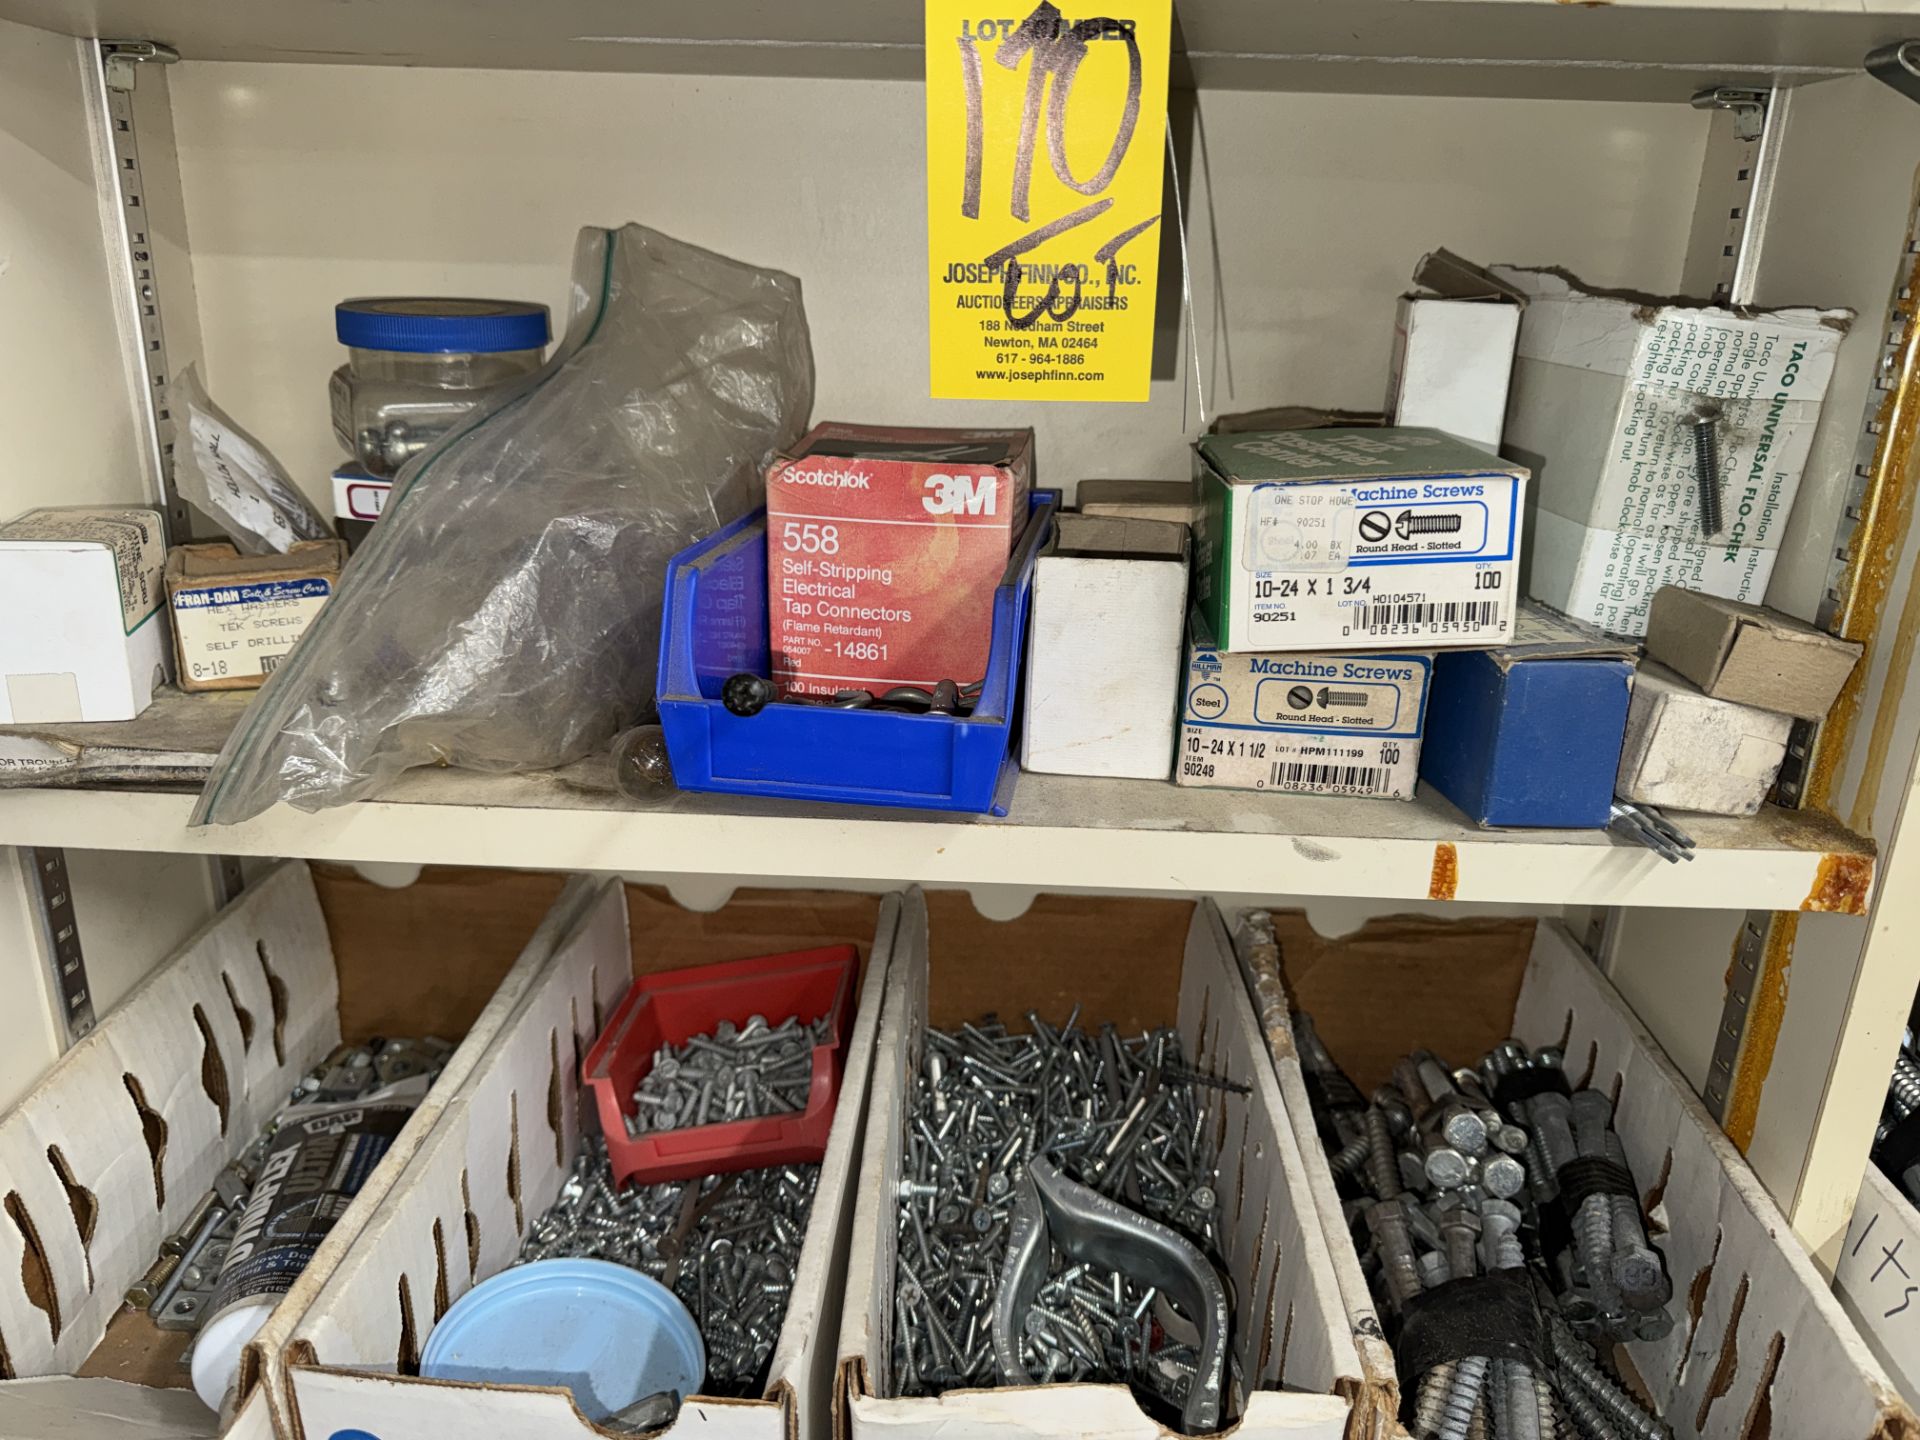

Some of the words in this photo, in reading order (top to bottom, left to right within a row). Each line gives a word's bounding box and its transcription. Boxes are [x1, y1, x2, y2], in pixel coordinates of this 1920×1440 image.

[962, 20, 1014, 41] LOT
[1017, 18, 1137, 42] UMBER
[944, 263, 1011, 285] JOSEPH
[1021, 264, 1059, 285] FINN
[1106, 265, 1142, 286] INC.
[956, 295, 1045, 310] AUCTIOEERS
[979, 320, 1000, 331] 188
[1005, 321, 1063, 332] Ndham
[1067, 321, 1105, 332] Street
[984, 336, 1034, 349] Newton,
[1038, 337, 1058, 348] MA
[1062, 338, 1098, 348] 02464
[1639, 319, 1670, 378] re-tighten
[1655, 321, 1685, 373] packing
[1672, 323, 1702, 375] packing
[1696, 326, 1718, 358] knob
[1738, 332, 1764, 369] angle
[1757, 335, 1779, 366] Taco
[996, 353, 1018, 364] 617
[1029, 354, 1084, 364] 964-1886
[1696, 328, 1732, 394] (operating
[1722, 330, 1747, 375] normal
[1779, 341, 1807, 386] TACO
[976, 370, 1104, 382] www.josephfinn.com
[1622, 384, 1650, 435] packing
[1733, 371, 1766, 429] Universal
[1643, 402, 1662, 427] and
[1636, 432, 1653, 456] turn
[1746, 392, 1789, 481] UNIVERSAL
[1619, 440, 1635, 463] nut.
[1649, 431, 1668, 465] return
[783, 467, 870, 489] Scotchlok
[1626, 460, 1647, 492] knob
[1644, 470, 1658, 481] to
[1675, 465, 1690, 479] To
[922, 474, 997, 515] 3M
[1275, 495, 1292, 505] ONE
[1299, 495, 1323, 505] STOP
[1346, 484, 1418, 502] achine
[1423, 484, 1484, 499] Screws
[1655, 485, 1667, 498] as
[1663, 483, 1682, 518] open,
[1682, 485, 1696, 506] are
[1630, 486, 1654, 531] normal
[1649, 502, 1665, 520] far
[1755, 472, 1788, 541] Installation
[1260, 517, 1278, 526] HF#
[1296, 518, 1326, 527] 90251
[1608, 496, 1637, 559] clock-wise
[1644, 524, 1656, 538] as
[1723, 487, 1757, 563] FLO-CHEK
[783, 522, 839, 554] 558
[1294, 541, 1318, 549] 4.00
[1330, 541, 1342, 550] BX
[1663, 510, 1693, 561] shipped
[1328, 552, 1340, 560] EA
[1356, 543, 1389, 553] Round
[1391, 542, 1418, 552] Head
[1427, 541, 1462, 550] Slotted
[1641, 542, 1653, 551] it
[782, 558, 892, 585] Self-Stripping
[1604, 563, 1615, 578] as
[1609, 534, 1642, 602] (operating)
[1634, 554, 1651, 576] will
[783, 578, 855, 599] Electrical
[1255, 579, 1299, 598] 10-24
[1307, 579, 1317, 595] X
[1327, 578, 1333, 595] 1
[1343, 577, 1371, 595] 3/4
[1474, 571, 1501, 589] 100
[1597, 581, 1613, 599] far
[1623, 579, 1640, 599] go.
[1633, 567, 1661, 617] packing
[207, 605, 232, 614] HEX
[783, 598, 811, 617] Tap
[816, 601, 911, 622] Connectors
[1253, 612, 1296, 622] 90251
[1593, 602, 1606, 617] as
[1618, 605, 1638, 633] Then
[220, 622, 245, 632] TEK
[253, 617, 302, 629] SCREWS
[783, 619, 820, 633] (Flame
[824, 623, 882, 639] Retardant)
[1370, 624, 1419, 635] 08236
[1431, 621, 1480, 633] 05950
[206, 641, 238, 651] SELF
[783, 635, 805, 645] PART
[825, 641, 888, 661] -14861
[193, 661, 227, 677] 8-18
[784, 656, 801, 667] Red
[1250, 658, 1337, 678] Machine
[1343, 663, 1412, 681] Screws
[784, 681, 805, 693] 100
[1195, 697, 1221, 708] Steel
[1276, 712, 1306, 722] Round
[1309, 714, 1334, 723] Head
[1342, 716, 1374, 725] Slotted
[1227, 741, 1235, 756] X
[1240, 742, 1244, 757] 1
[1250, 743, 1266, 758] 1/2
[1380, 748, 1400, 765] 100
[1184, 762, 1215, 777] 90248
[1284, 782, 1324, 792] 08236
[1332, 785, 1373, 795] 05949
[1393, 789, 1400, 798] 6
